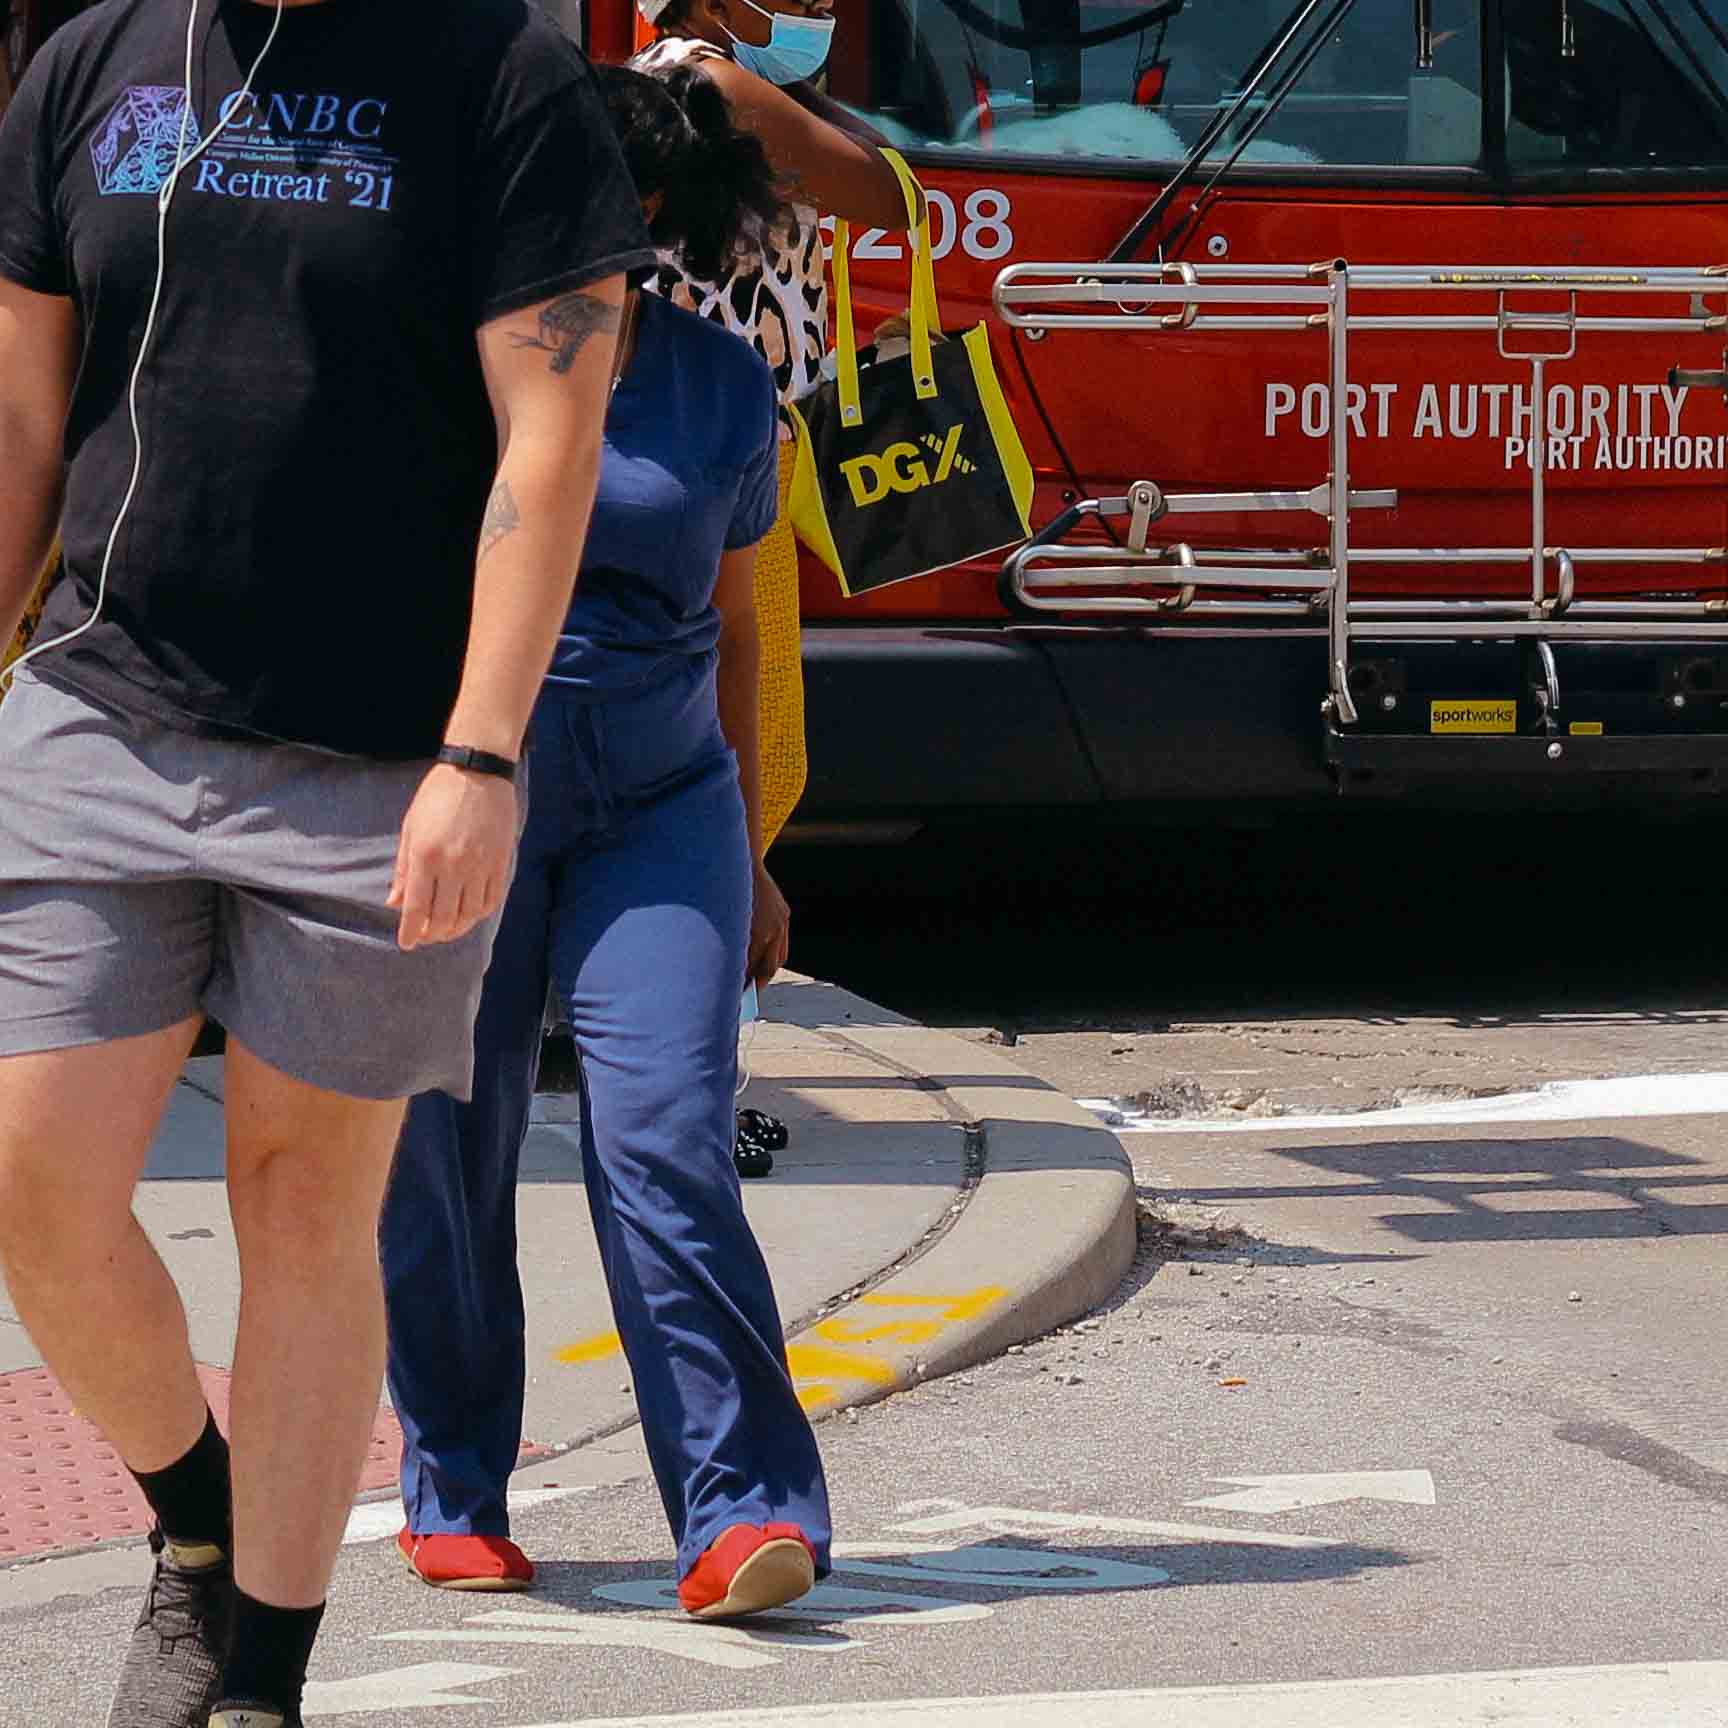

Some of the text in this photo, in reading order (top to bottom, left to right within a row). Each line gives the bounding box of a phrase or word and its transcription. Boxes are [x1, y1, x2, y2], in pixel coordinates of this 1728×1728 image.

[216, 88, 388, 138] CNBC
[193, 158, 332, 203] Retreat
[1264, 383, 1689, 439] PORT AUTHORITY
[838, 423, 977, 508] DGX
[1432, 706, 1513, 725] sportworks
